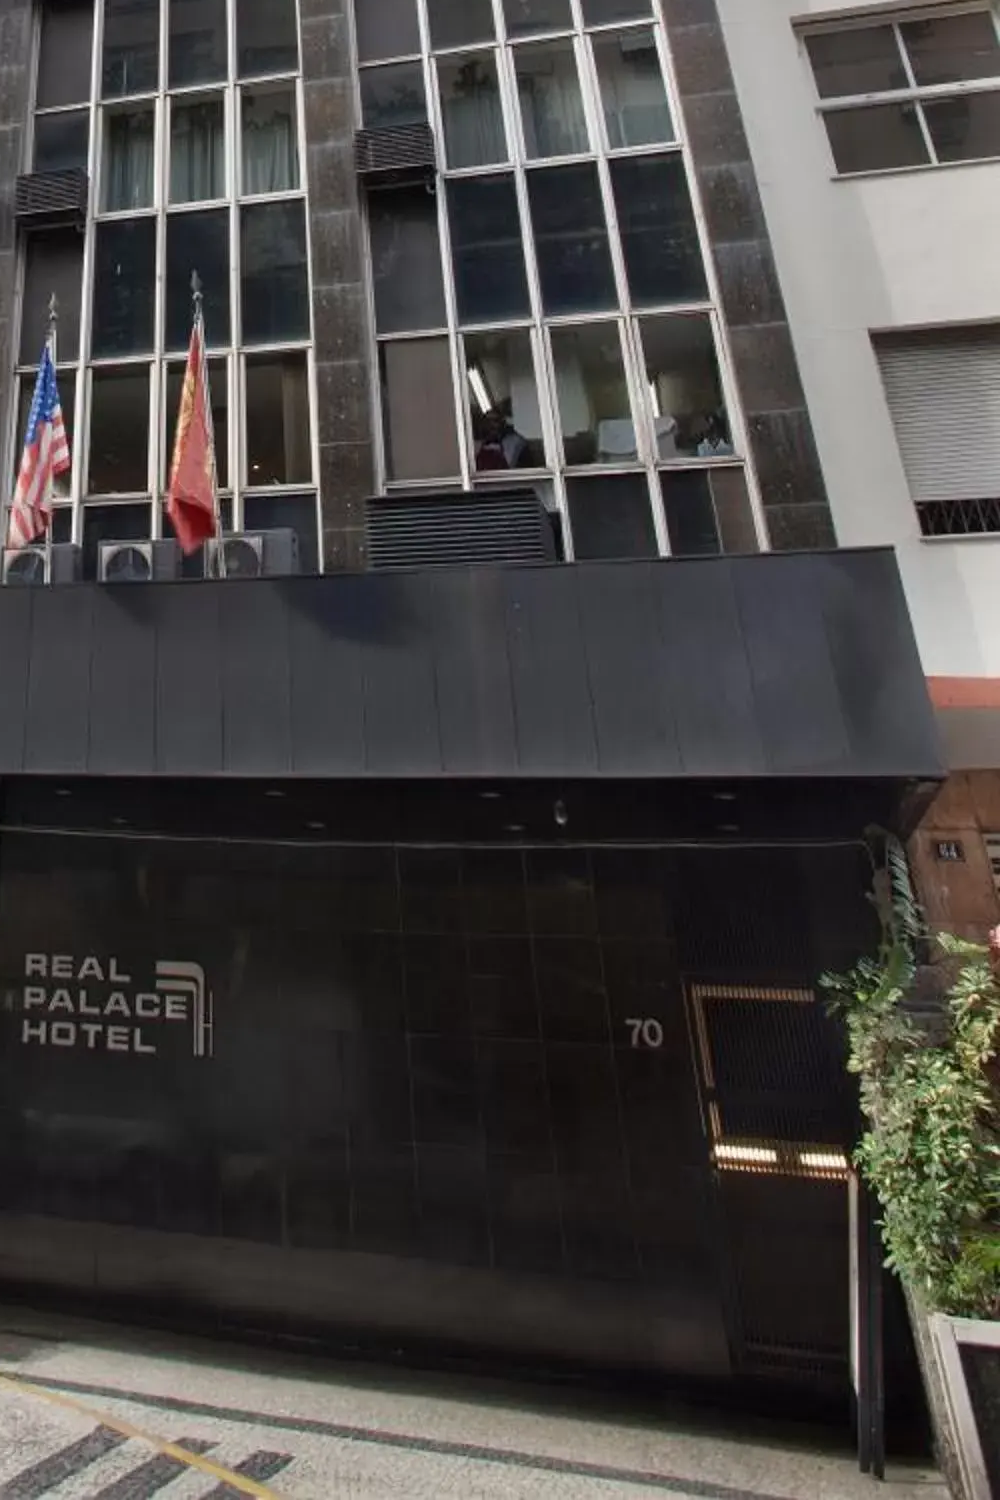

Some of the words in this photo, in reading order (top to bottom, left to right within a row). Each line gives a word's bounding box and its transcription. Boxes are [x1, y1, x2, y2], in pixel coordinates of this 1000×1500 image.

[25, 953, 131, 983] REAL
[23, 986, 188, 1019] PALACE
[21, 1019, 156, 1053] HOTEL
[625, 1018, 663, 1048] 70
